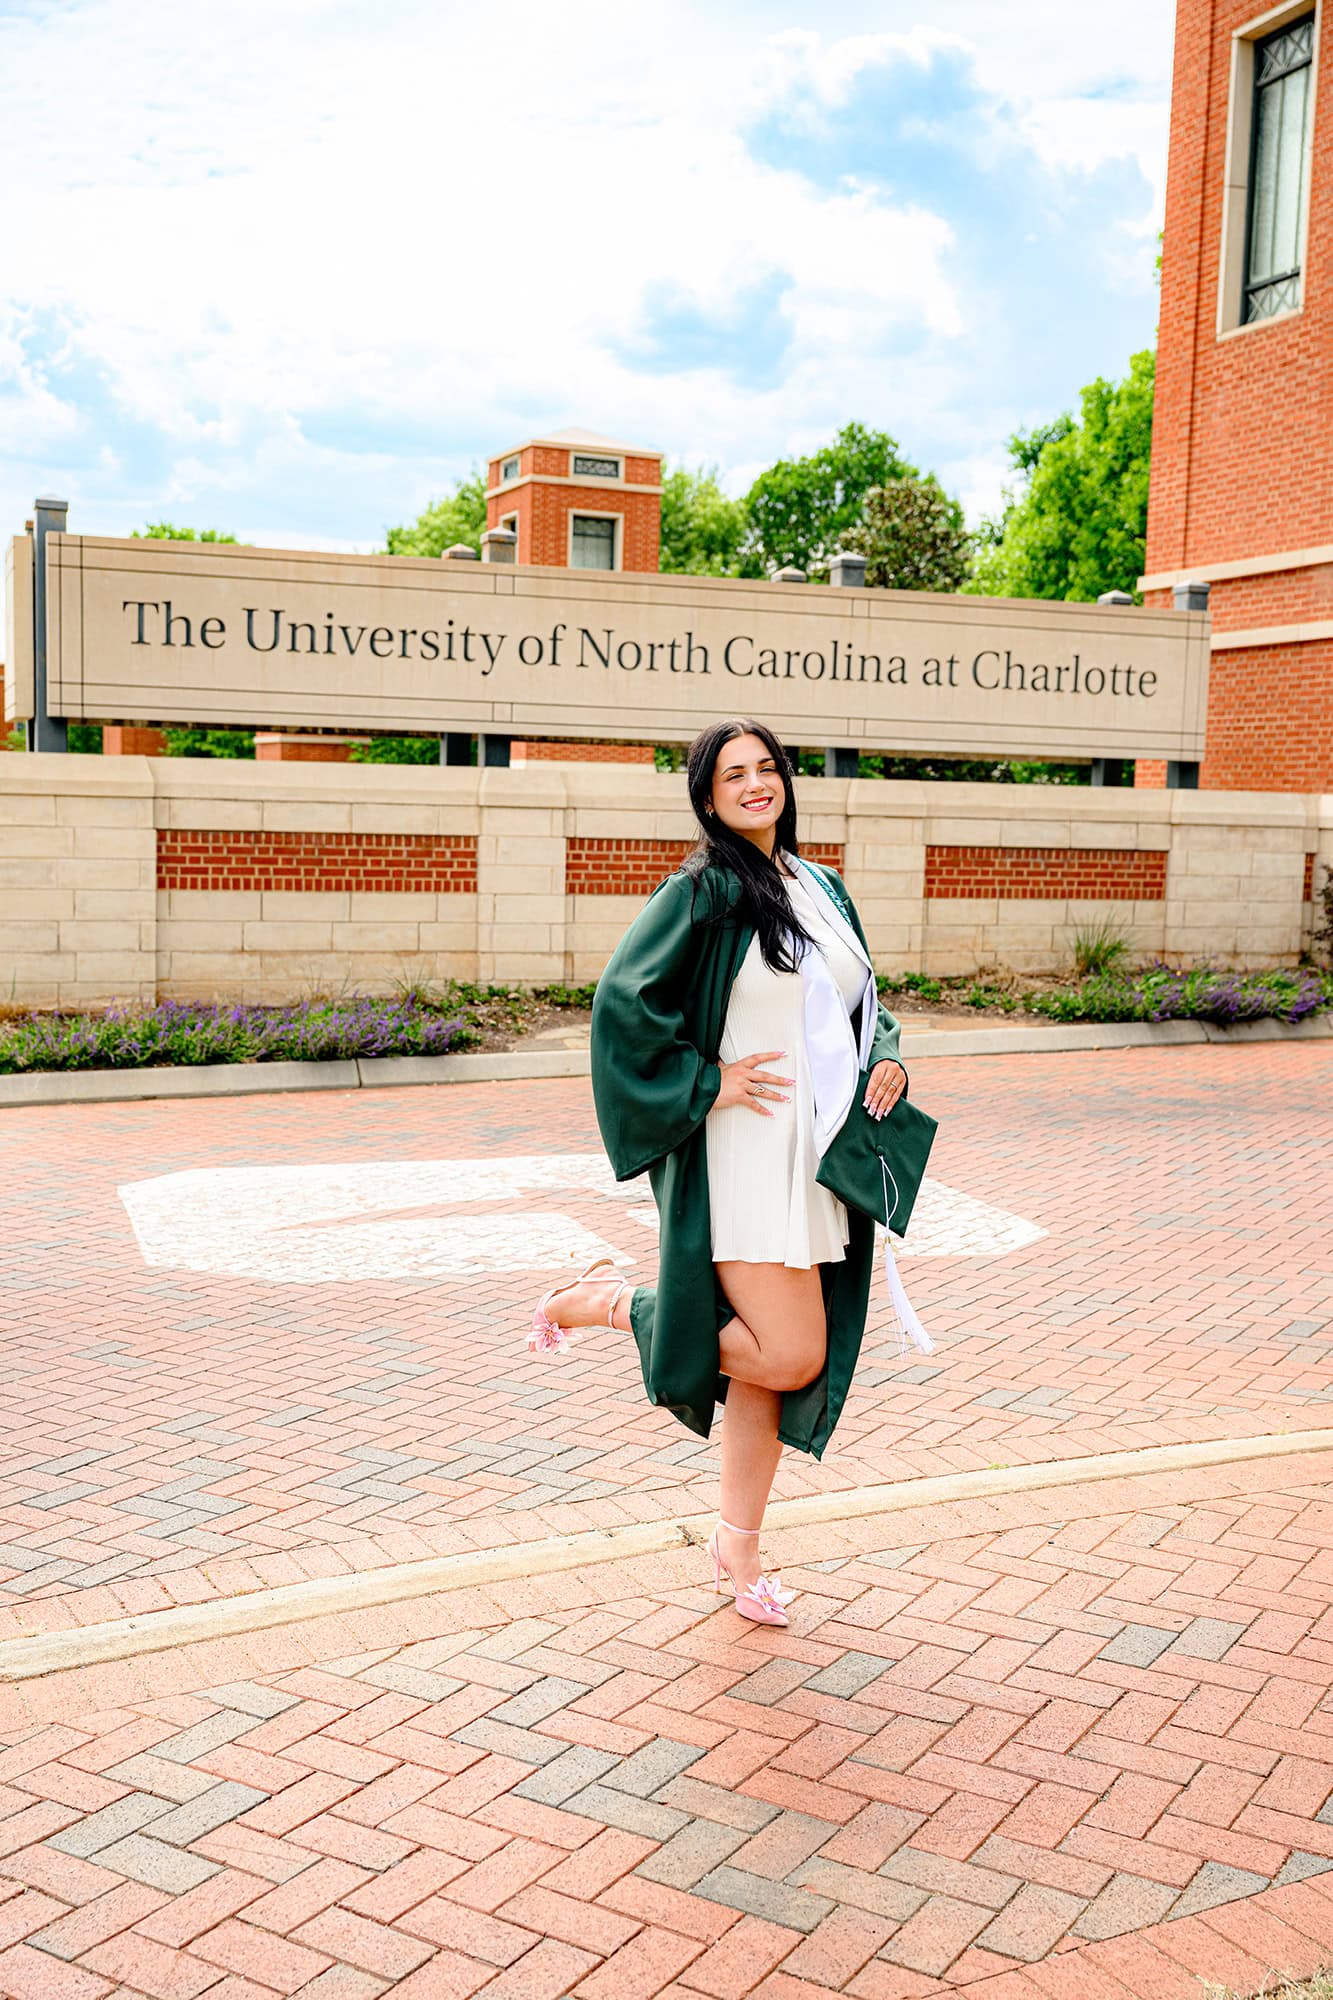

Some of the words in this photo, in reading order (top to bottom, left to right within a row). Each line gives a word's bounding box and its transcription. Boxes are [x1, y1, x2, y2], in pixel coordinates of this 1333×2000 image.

[122, 600, 226, 649] The
[242, 606, 507, 676] University
[518, 623, 567, 667] of
[576, 627, 710, 674] North
[723, 636, 908, 686] Carolina
[922, 654, 960, 688] at
[972, 650, 1158, 698] Charlotte
